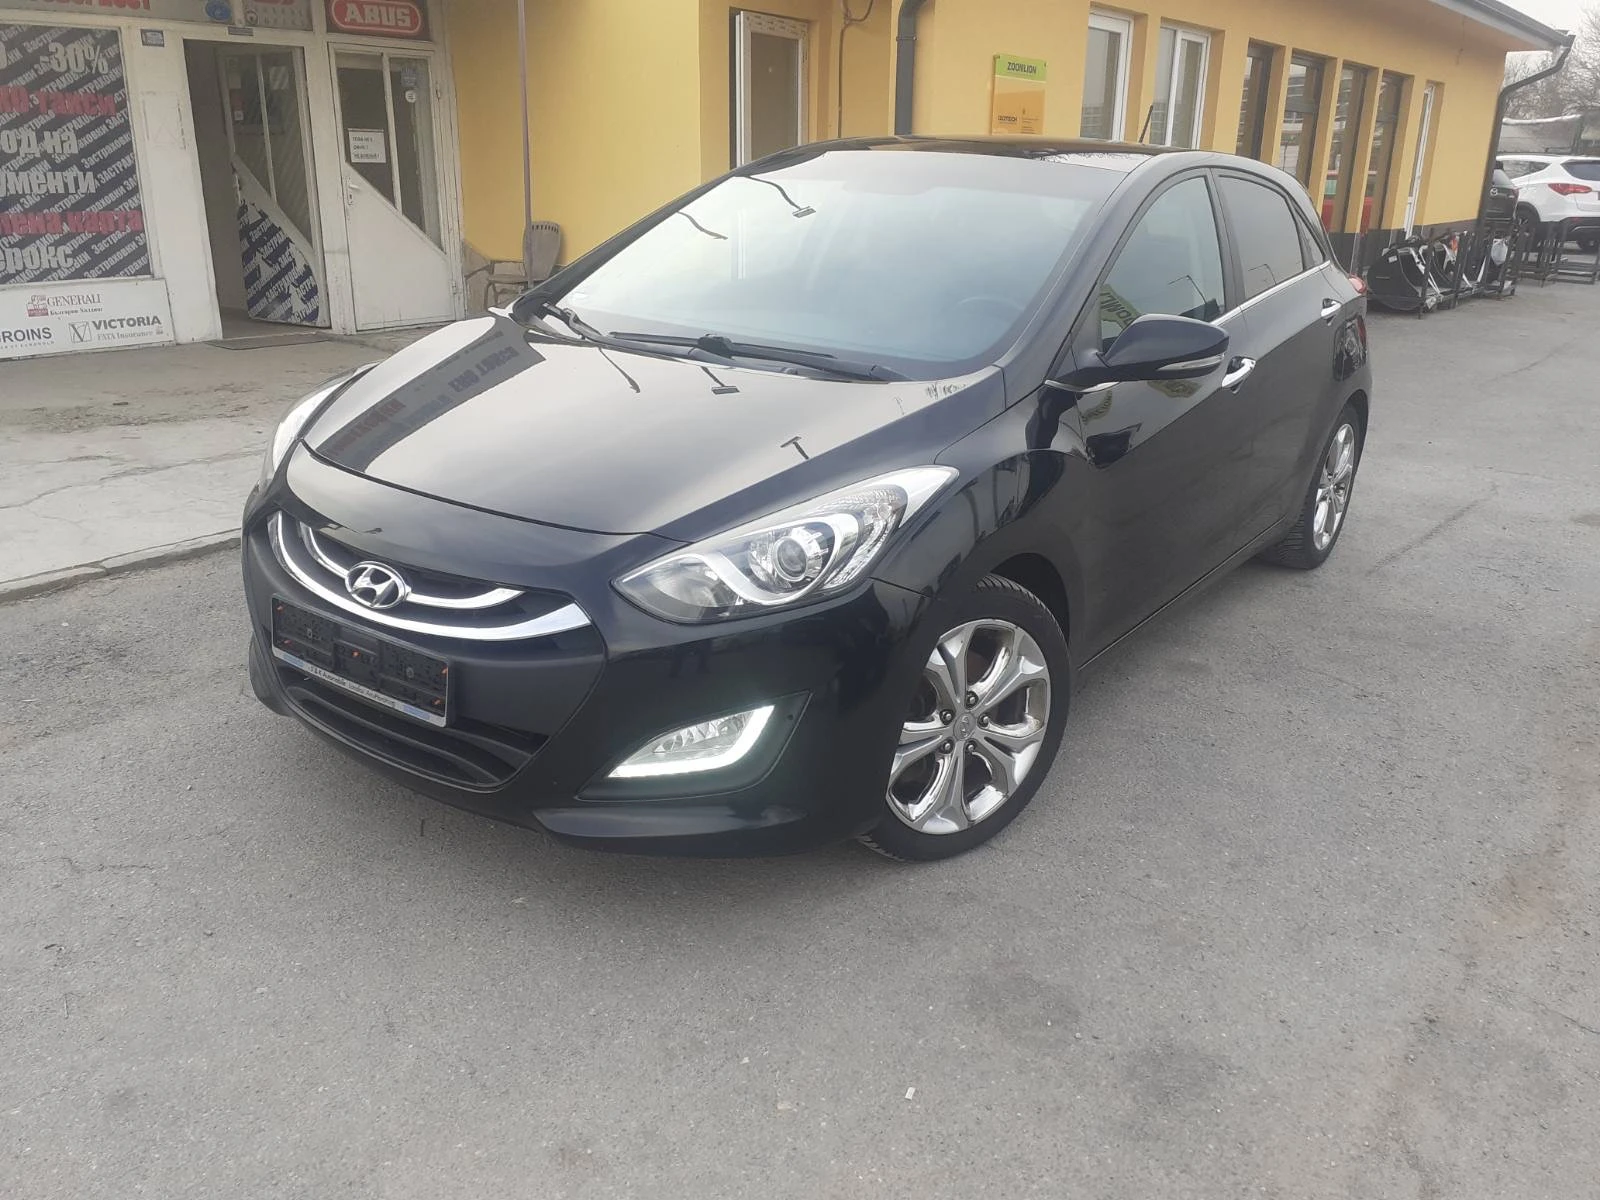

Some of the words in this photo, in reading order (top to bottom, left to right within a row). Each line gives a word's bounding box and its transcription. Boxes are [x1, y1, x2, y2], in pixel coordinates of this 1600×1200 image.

[345, 3, 411, 27] ABUS
[47, 293, 102, 307] GENERALI
[91, 315, 162, 331] VICTORIA
[0, 327, 52, 343] ROINS
